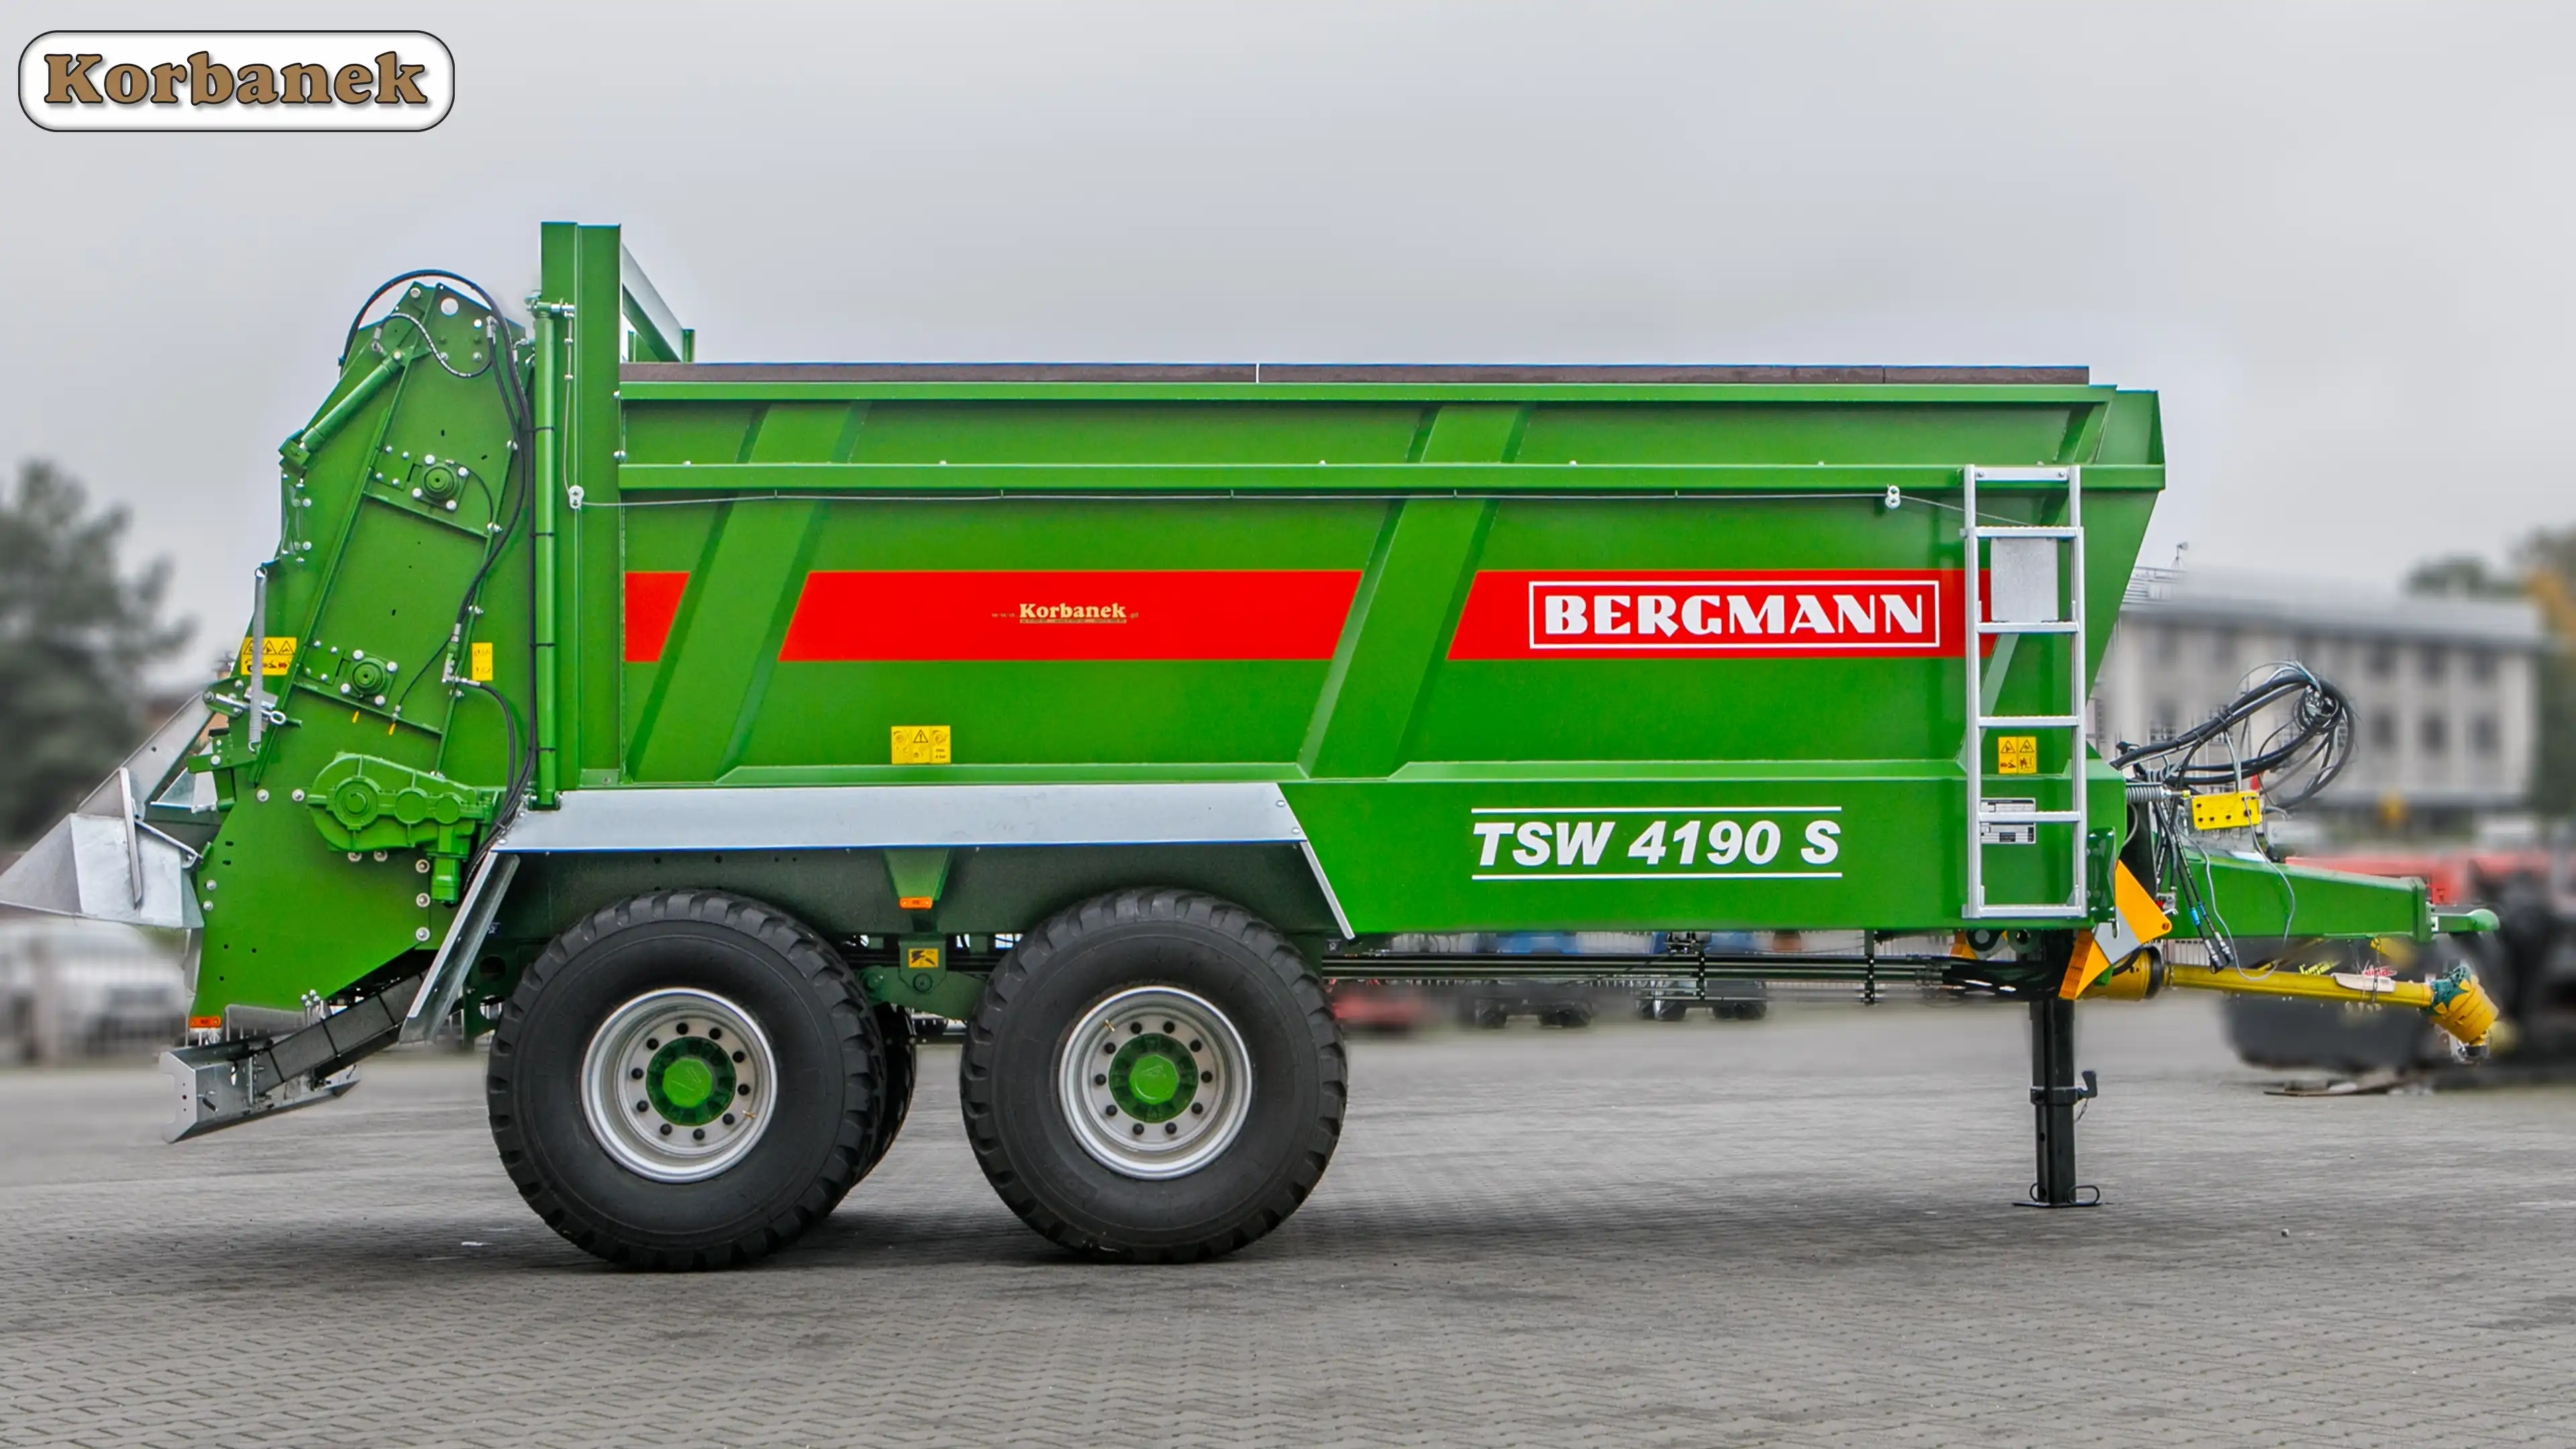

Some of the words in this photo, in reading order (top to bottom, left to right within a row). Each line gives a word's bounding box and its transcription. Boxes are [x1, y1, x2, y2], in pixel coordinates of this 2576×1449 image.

[1545, 594, 1923, 637] BERGMANN
[1473, 821, 1616, 867] TSW
[1627, 820, 1781, 865] 4190
[1801, 820, 1841, 865] S
